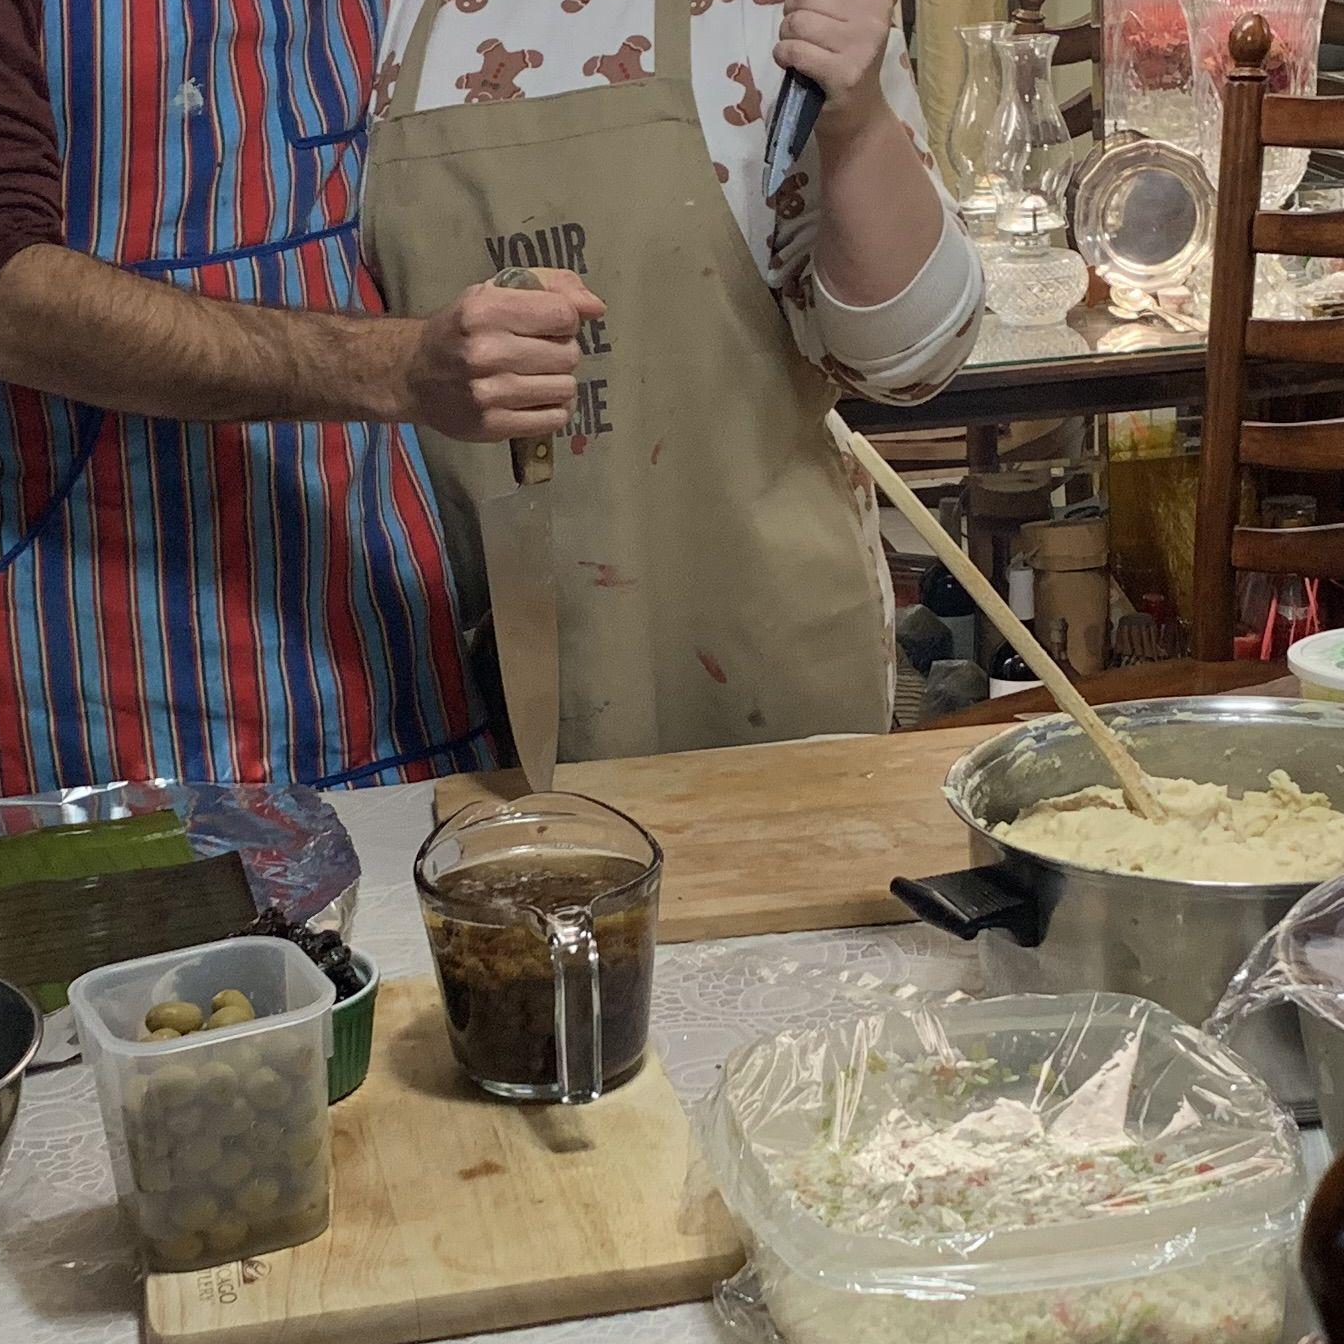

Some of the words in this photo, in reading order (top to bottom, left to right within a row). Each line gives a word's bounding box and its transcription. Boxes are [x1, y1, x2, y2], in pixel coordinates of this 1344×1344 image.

[484, 222, 588, 275] YOUR
[197, 1269, 216, 1304] TLERY
[216, 1265, 238, 1305] CAGO
